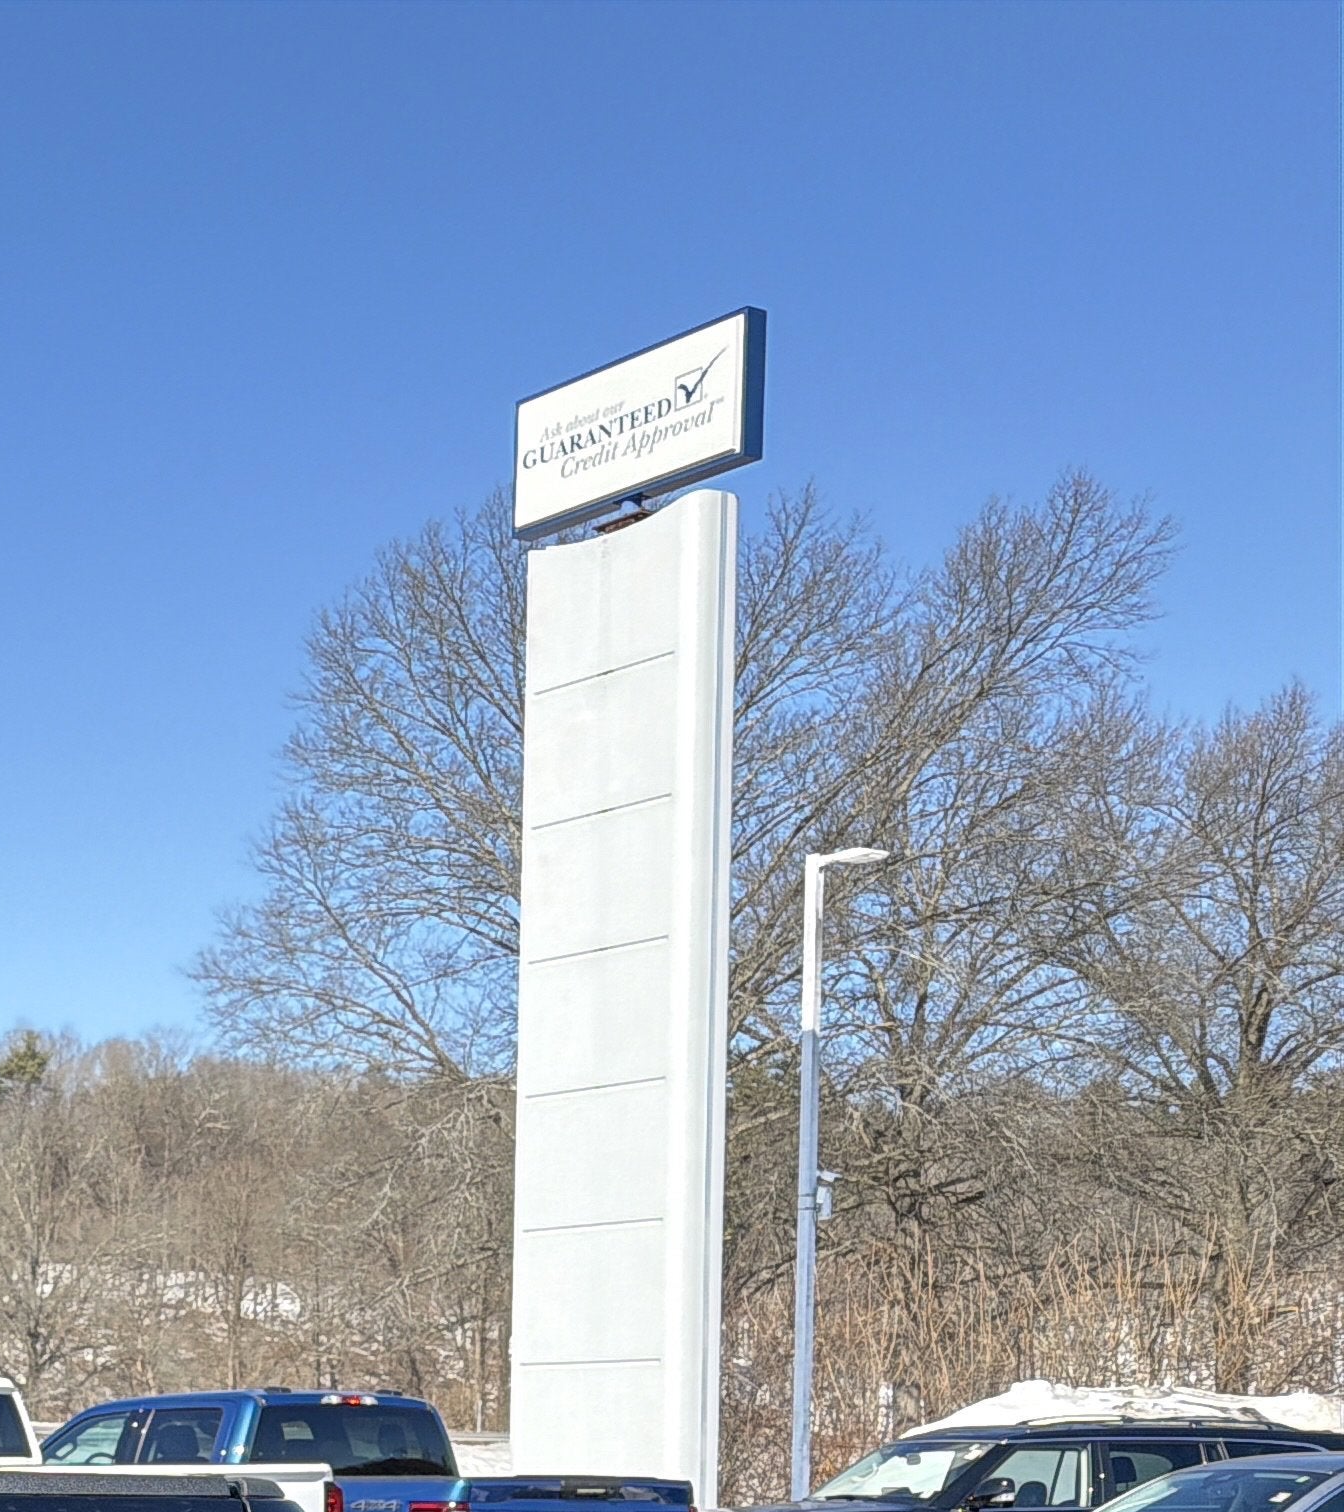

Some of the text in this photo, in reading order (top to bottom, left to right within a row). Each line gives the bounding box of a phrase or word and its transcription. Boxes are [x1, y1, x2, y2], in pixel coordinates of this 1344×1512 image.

[522, 397, 672, 470] GUARANTEED
[539, 421, 563, 443] Ask
[565, 407, 601, 433] about
[560, 399, 715, 479] Credit Approval
